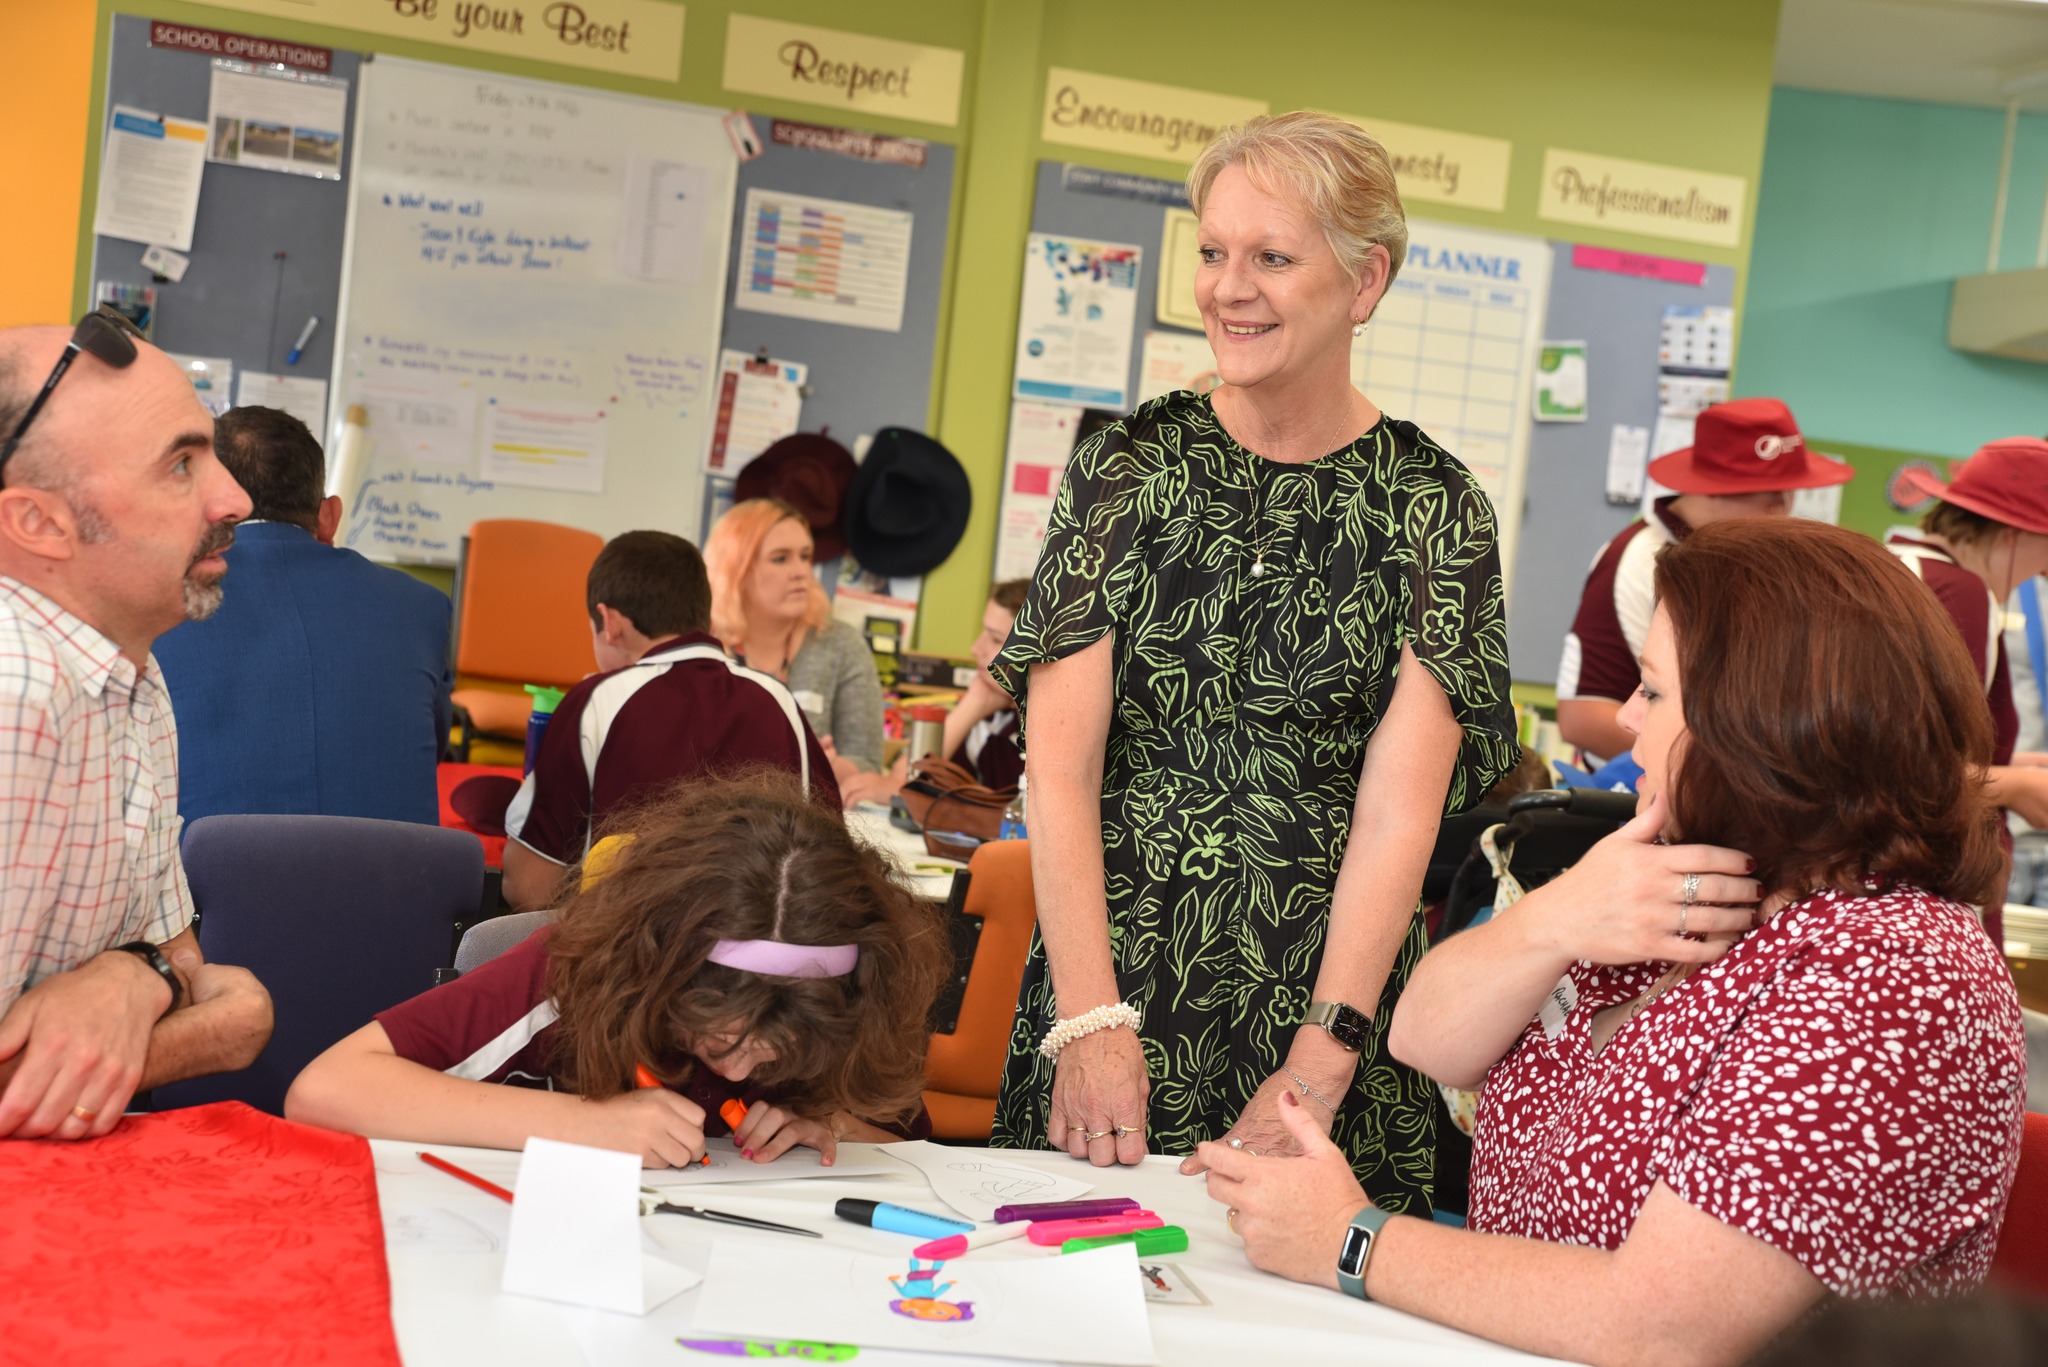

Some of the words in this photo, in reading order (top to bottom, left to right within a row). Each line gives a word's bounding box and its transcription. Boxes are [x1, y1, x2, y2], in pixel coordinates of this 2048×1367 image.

[155, 26, 223, 51] SCHOOL
[224, 36, 328, 69] OPERATIONS
[452, 2, 524, 38] your
[543, 2, 630, 53] Best
[778, 39, 911, 100] Respect
[1553, 165, 1732, 225] Professionalism
[1406, 243, 1521, 283] PLANNER
